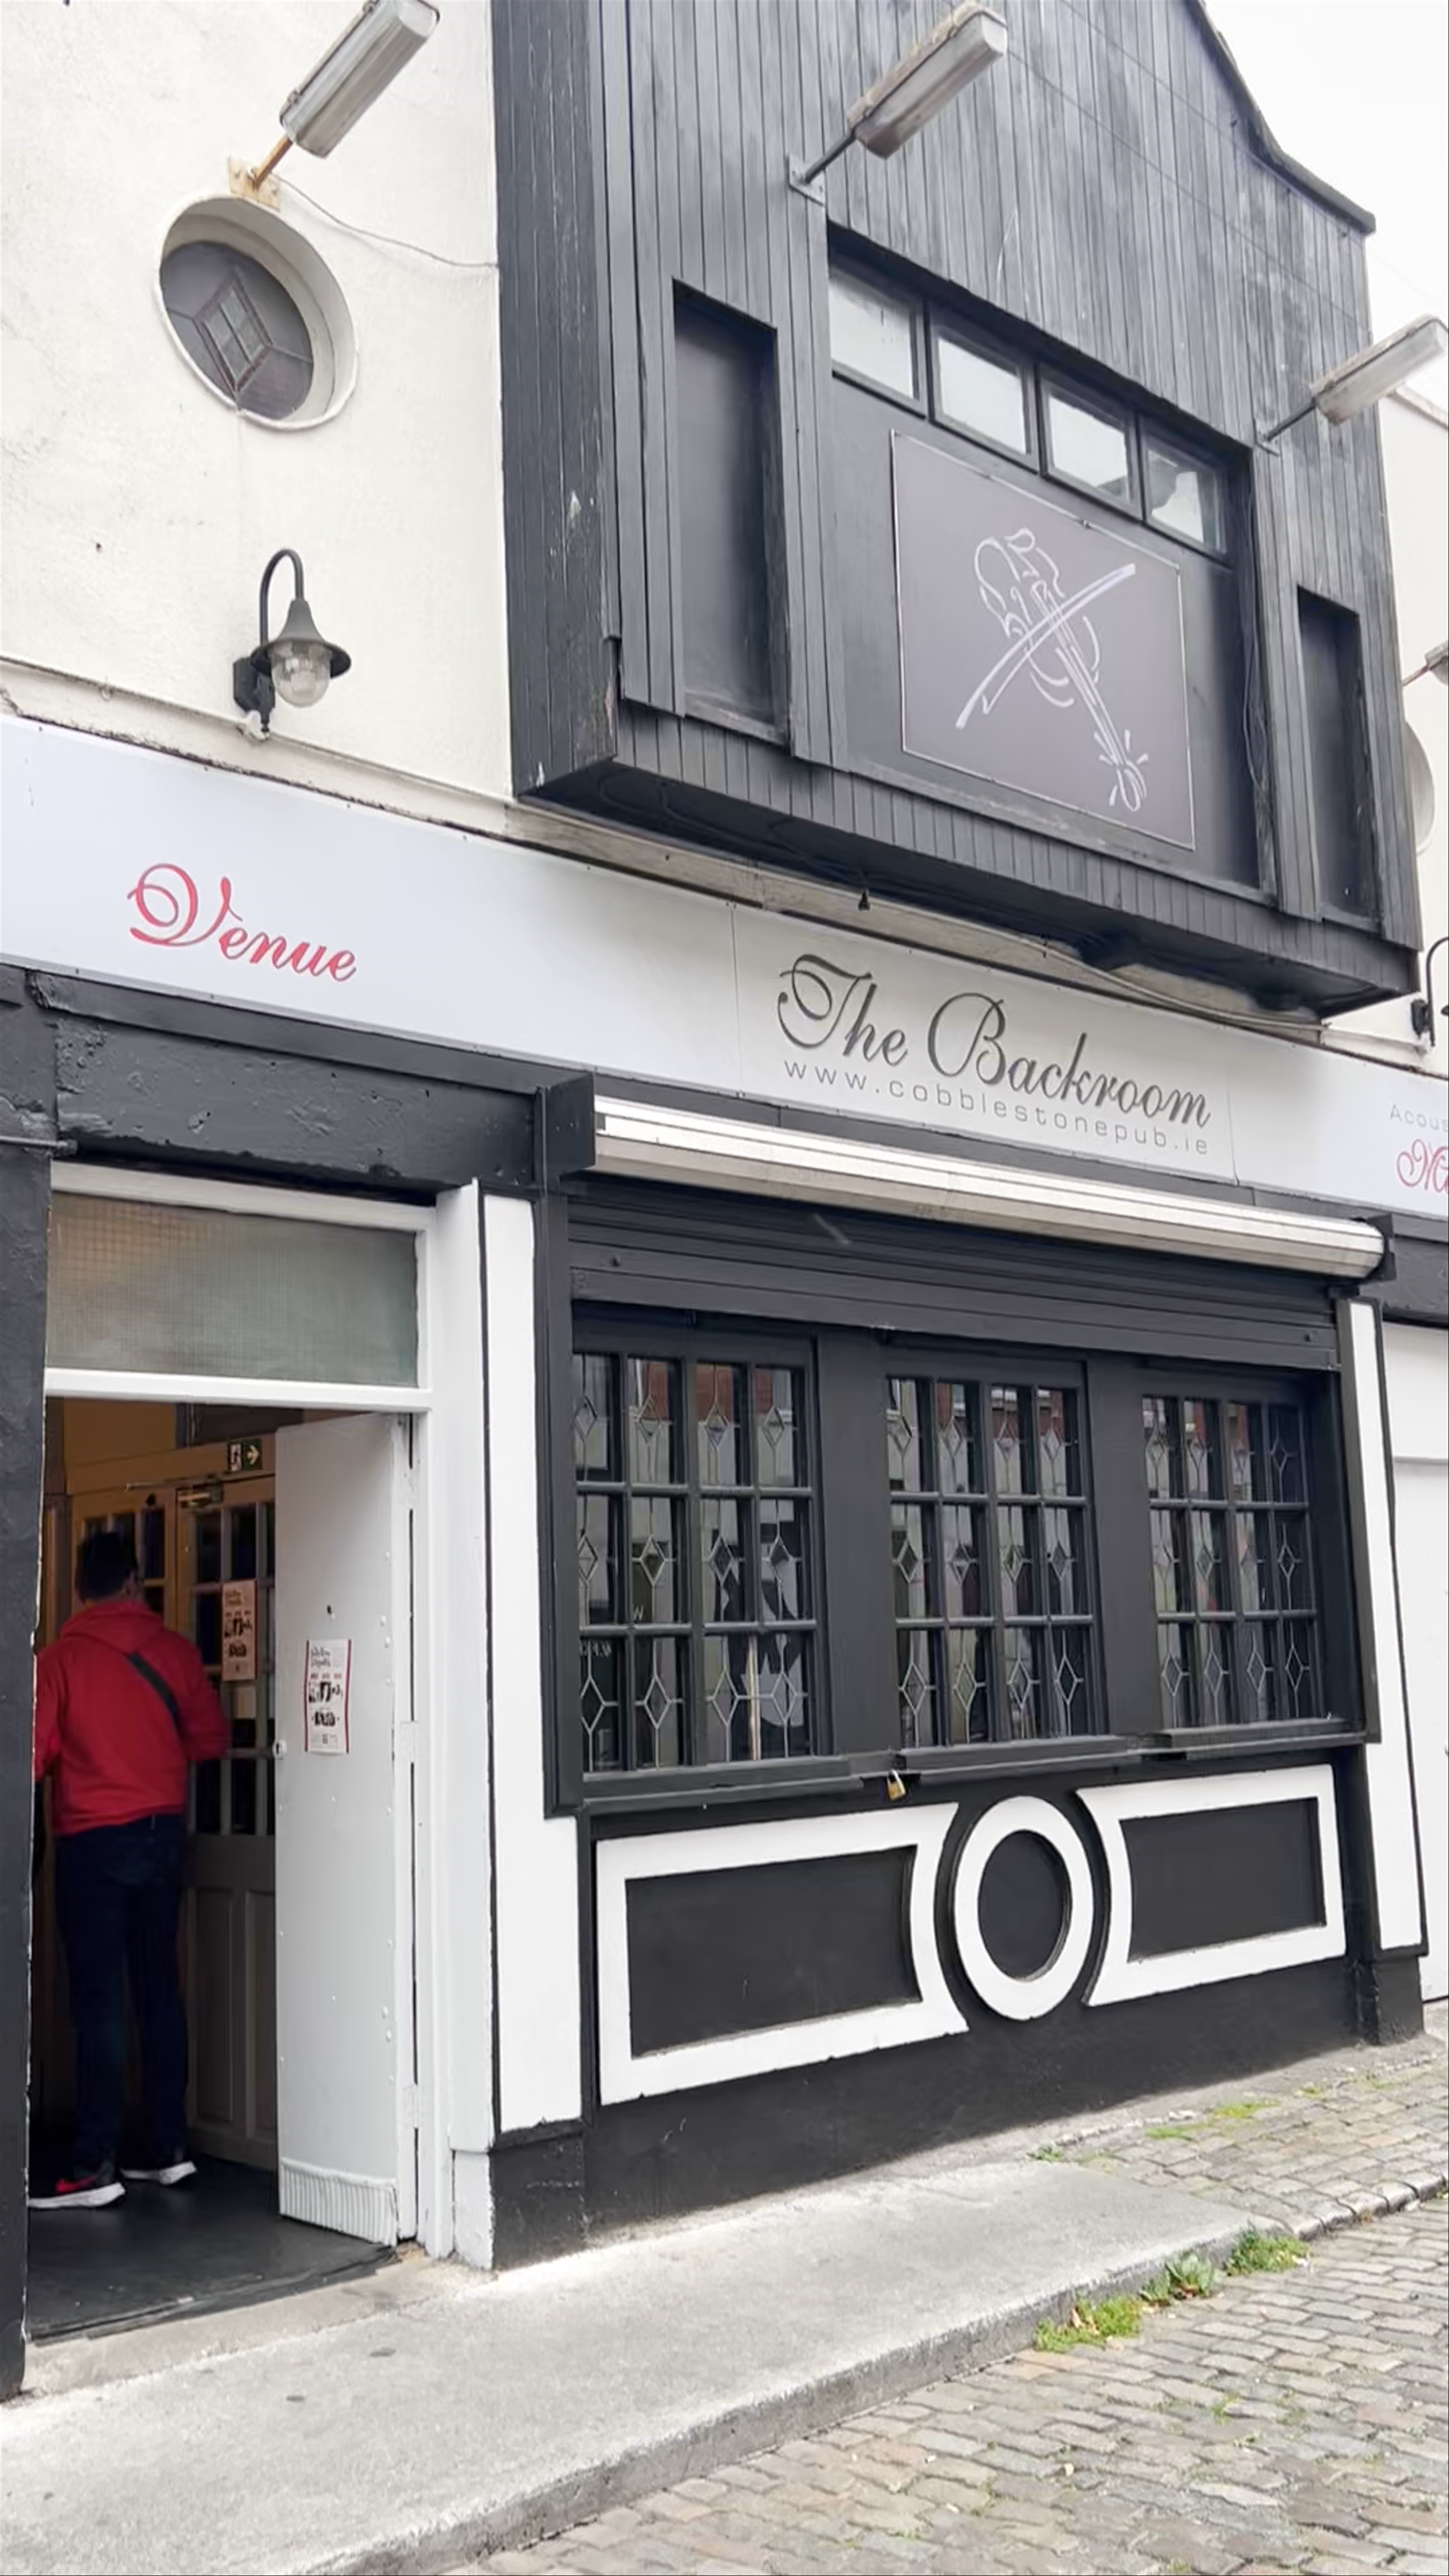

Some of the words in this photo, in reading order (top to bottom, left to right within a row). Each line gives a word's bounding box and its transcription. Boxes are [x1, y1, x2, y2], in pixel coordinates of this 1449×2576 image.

[127, 863, 357, 982] Venue
[777, 954, 908, 1066] The
[928, 992, 1211, 1128] Backroom
[784, 1060, 1208, 1155] www.cobblestonepub.ie
